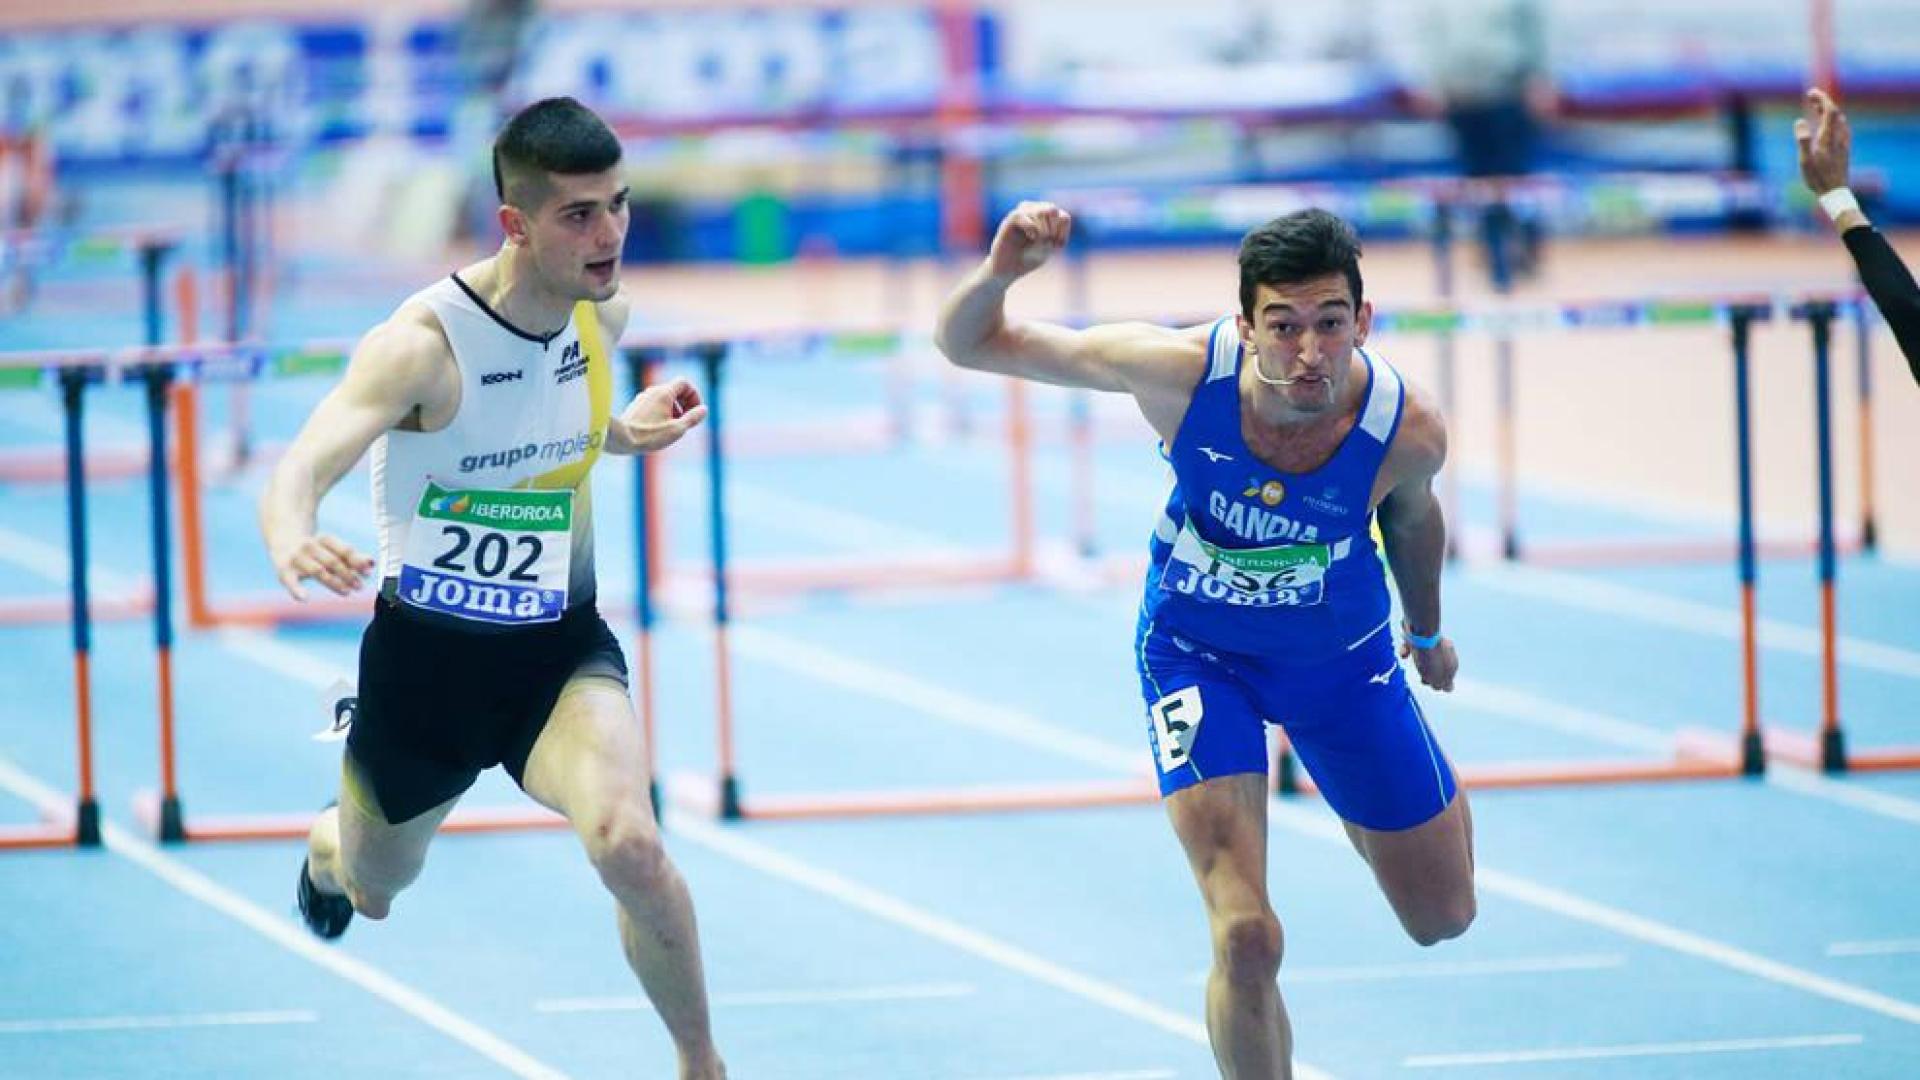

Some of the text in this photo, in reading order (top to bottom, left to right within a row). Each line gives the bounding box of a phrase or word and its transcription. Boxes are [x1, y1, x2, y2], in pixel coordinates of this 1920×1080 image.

[458, 443, 538, 473] grupo
[470, 502, 565, 521] IBERDROLA
[1209, 490, 1319, 543] GANDIA
[433, 525, 544, 583] 202
